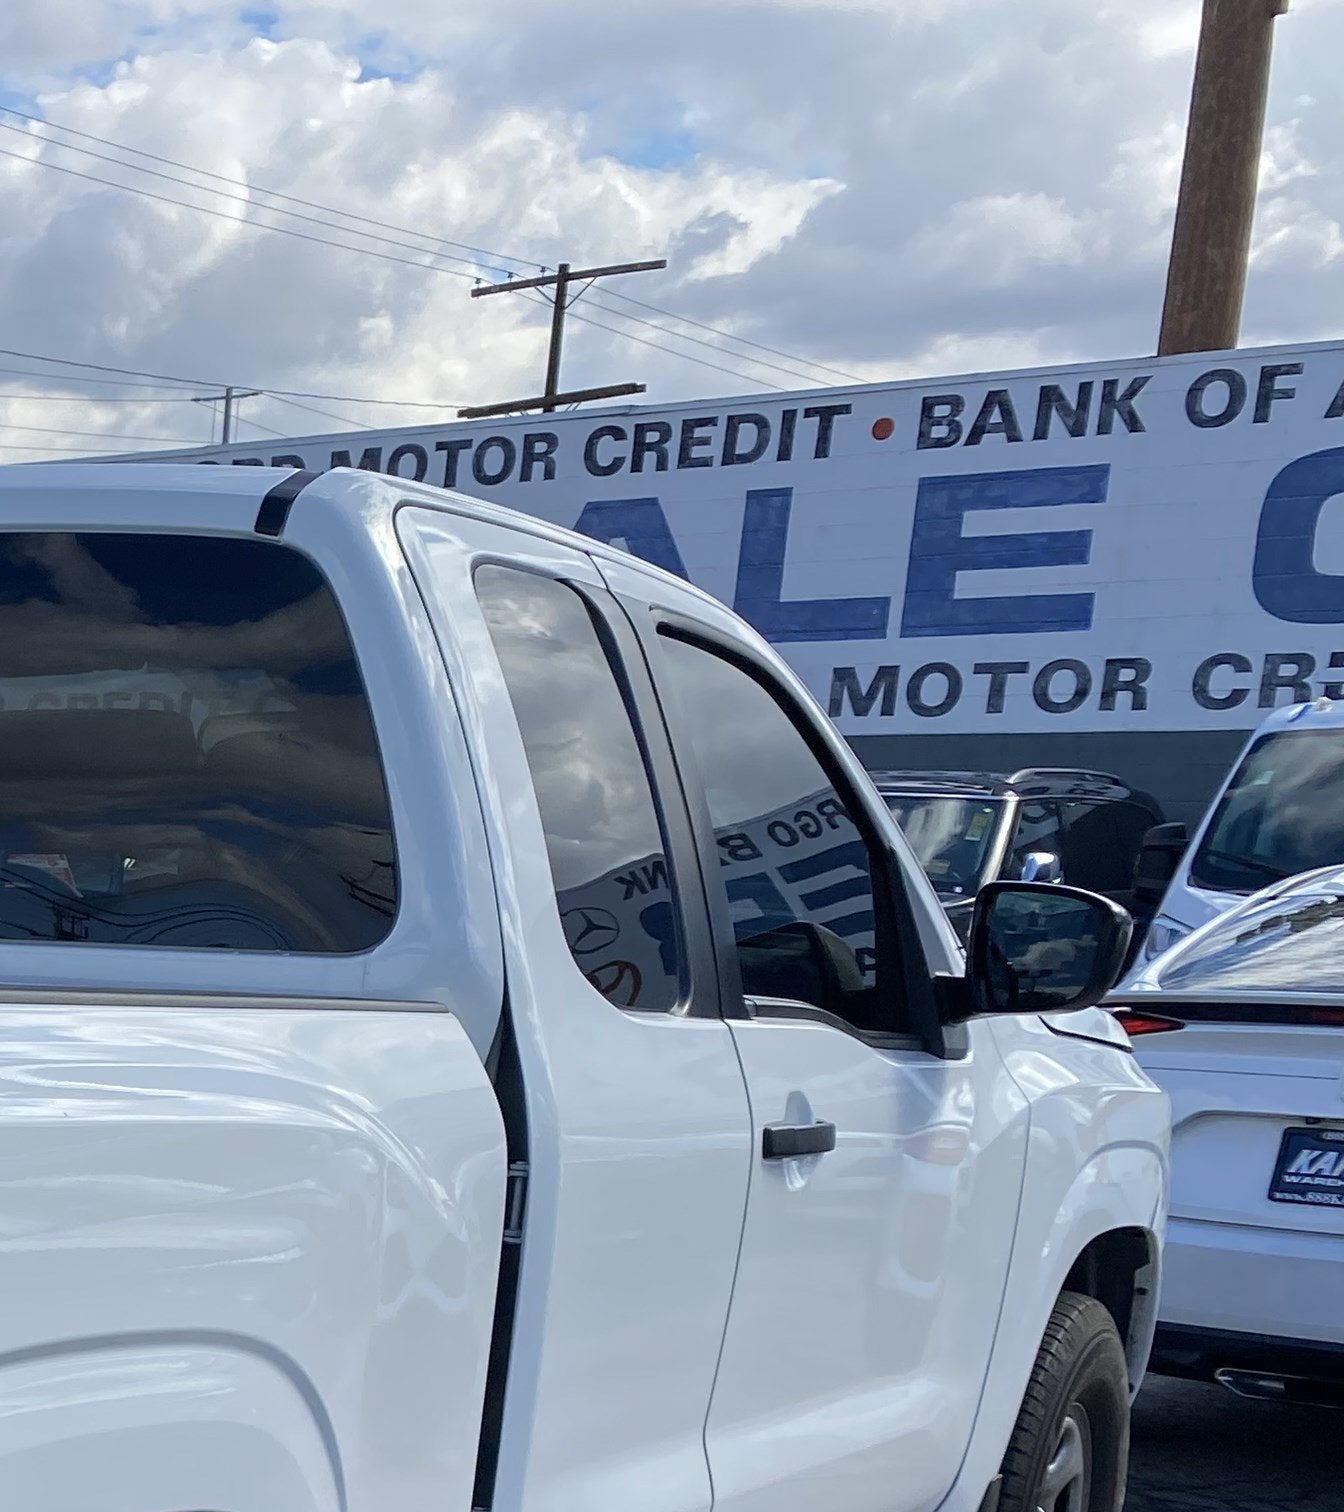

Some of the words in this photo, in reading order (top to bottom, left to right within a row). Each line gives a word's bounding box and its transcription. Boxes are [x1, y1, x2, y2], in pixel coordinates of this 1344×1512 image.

[584, 403, 852, 477] CREDIT
[917, 376, 1153, 450] BANK
[1185, 363, 1304, 428] OF
[830, 657, 1153, 718] MOTOR
